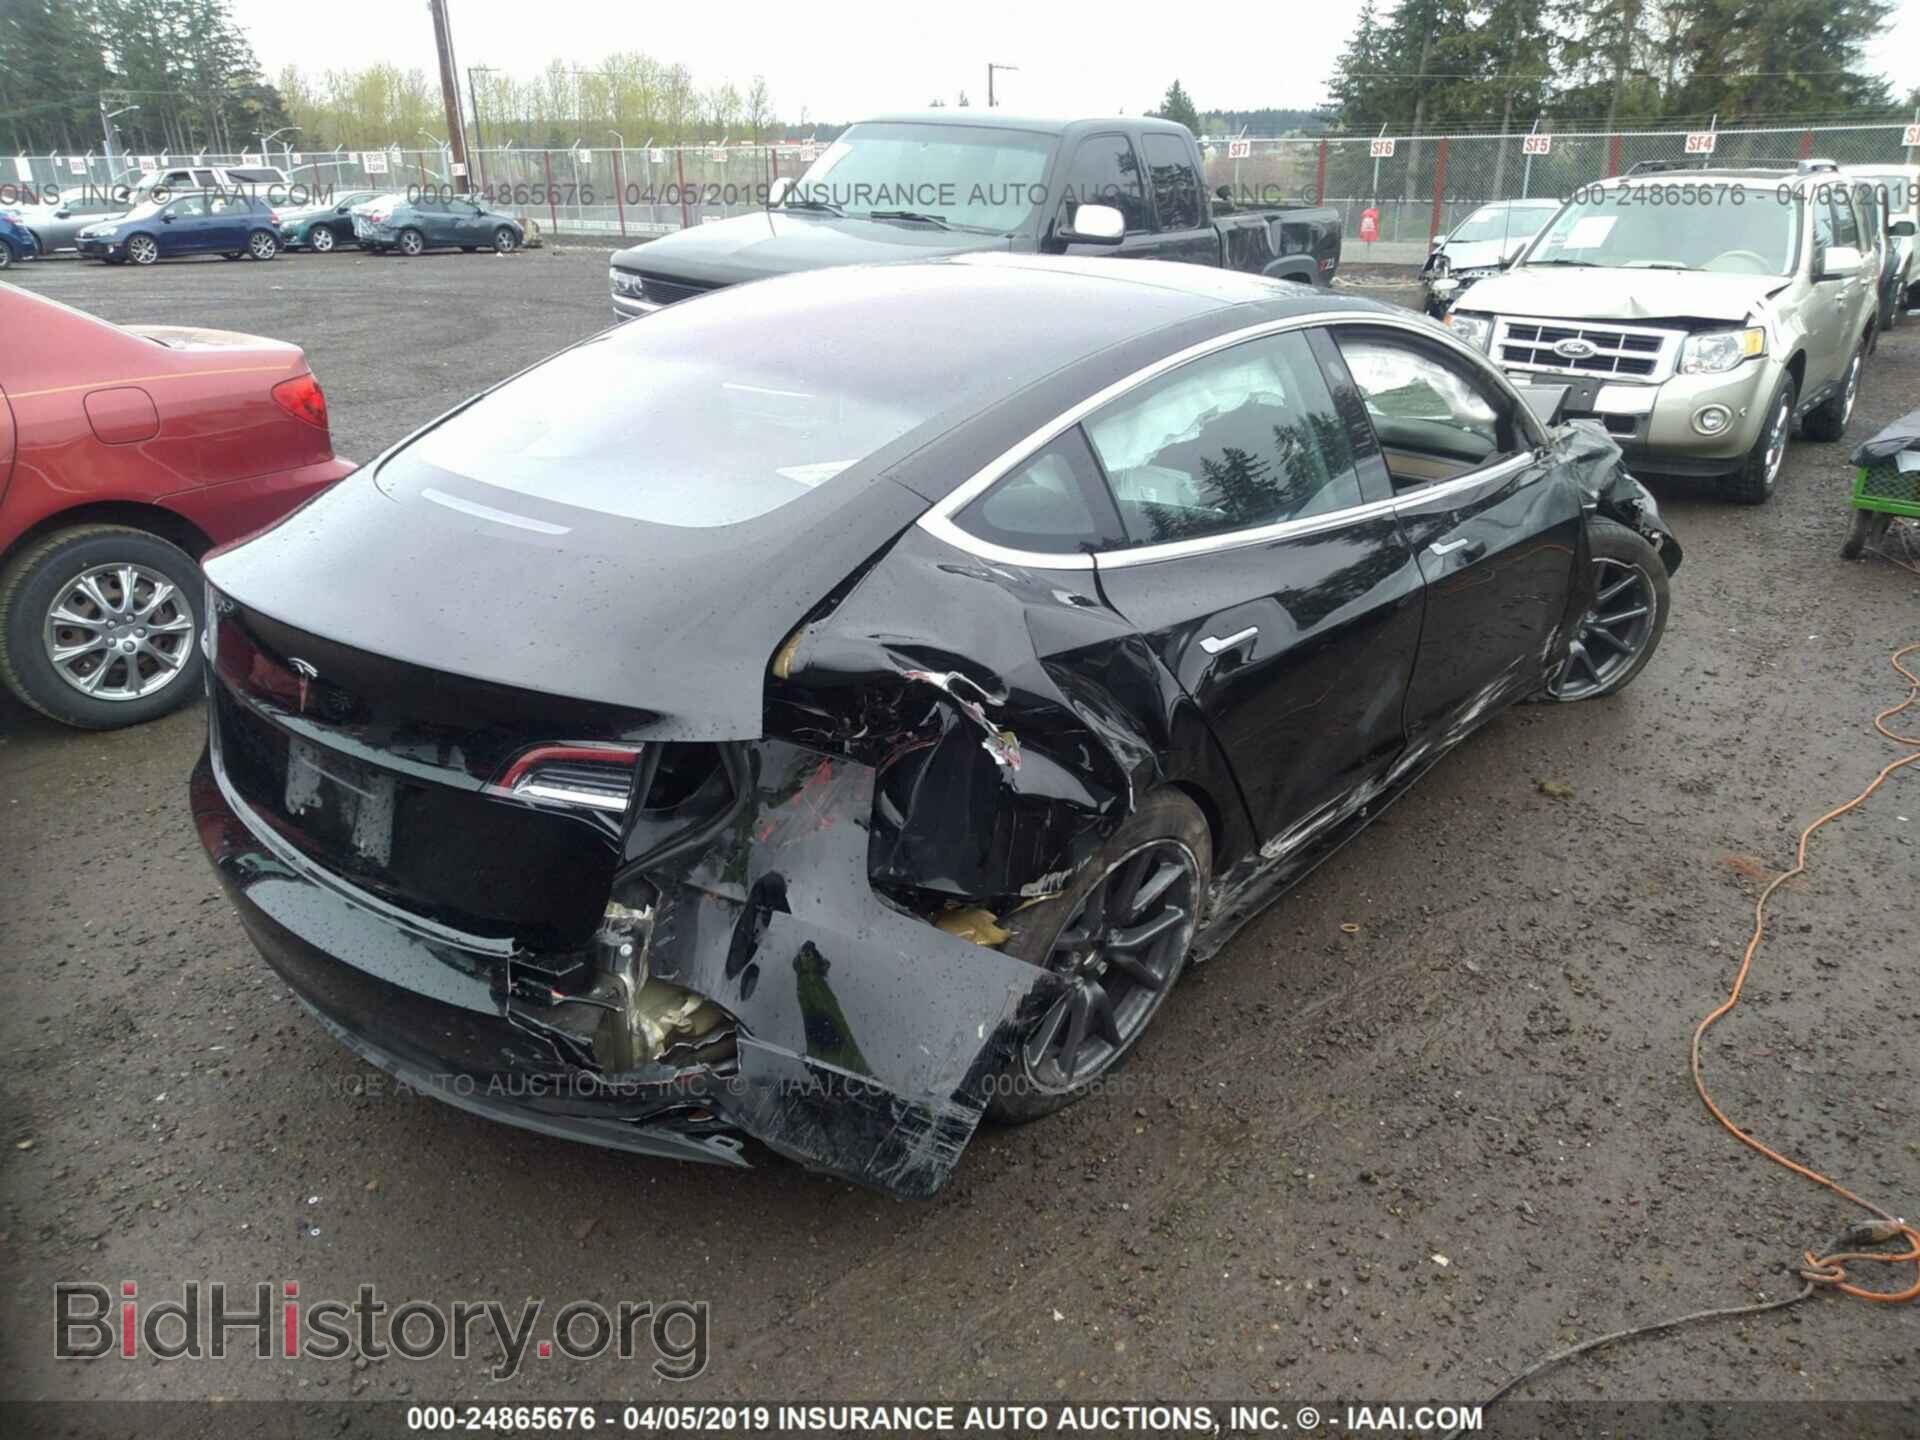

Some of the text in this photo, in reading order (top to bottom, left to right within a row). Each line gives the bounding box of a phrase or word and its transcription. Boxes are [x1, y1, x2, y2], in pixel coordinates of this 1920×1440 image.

[1230, 142, 1249, 156] SF7
[1372, 140, 1393, 155] SF6
[1525, 135, 1549, 152] SF5
[1687, 134, 1713, 150] SF4
